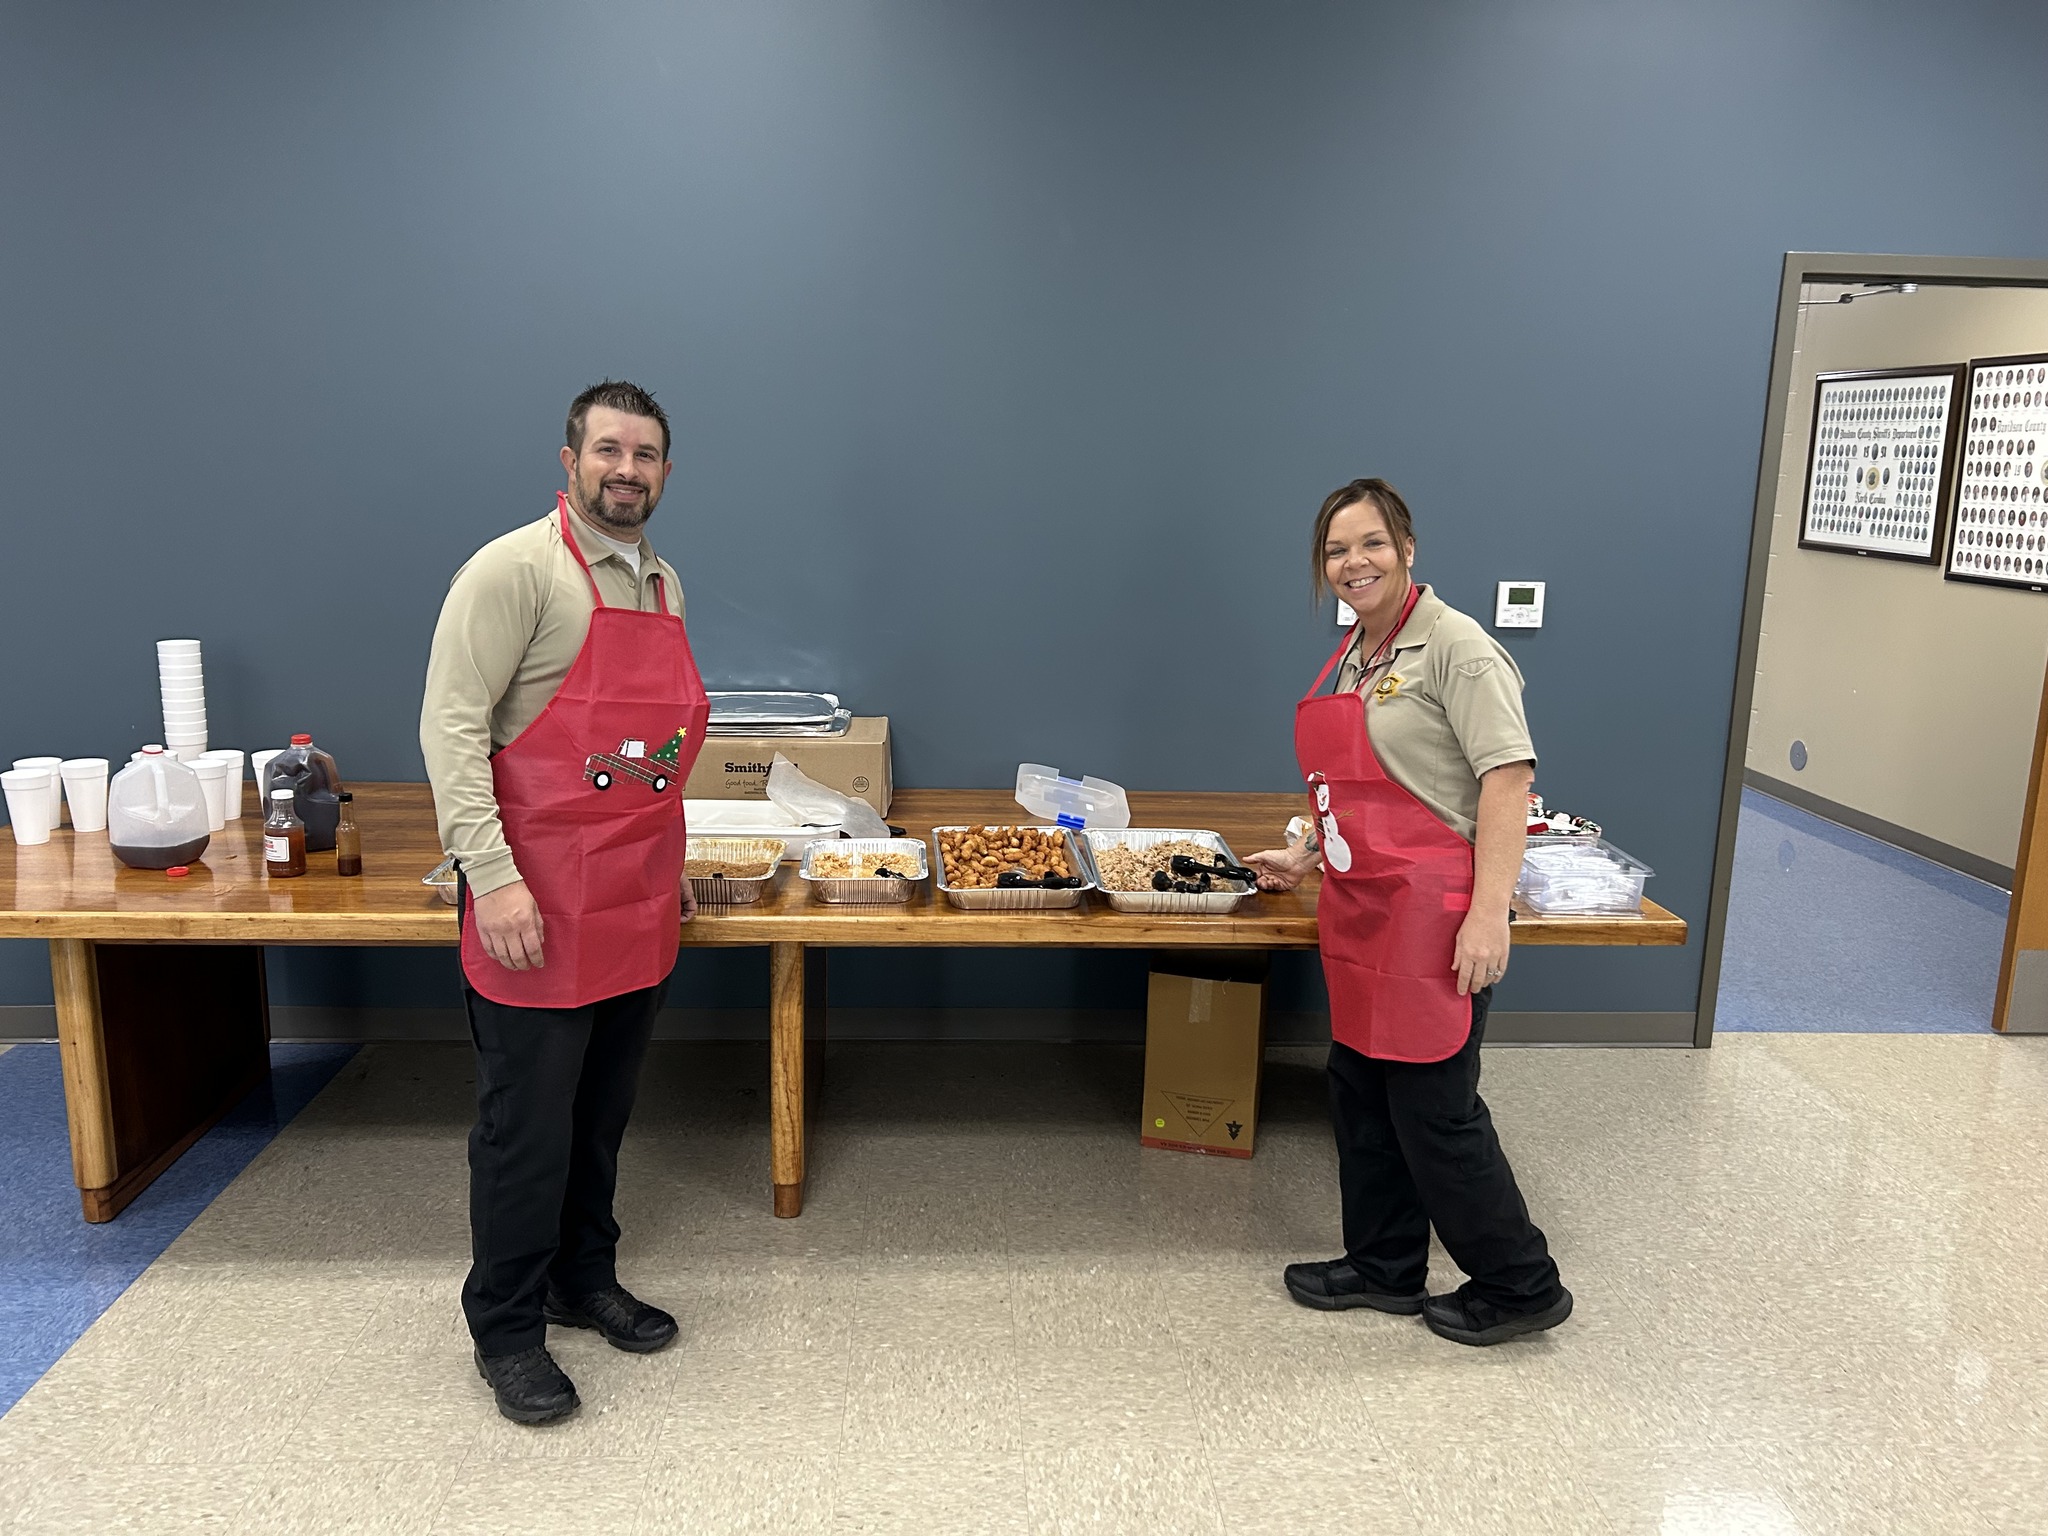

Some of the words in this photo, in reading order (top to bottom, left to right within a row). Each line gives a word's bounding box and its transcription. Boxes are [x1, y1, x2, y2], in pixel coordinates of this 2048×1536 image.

[1997, 420, 2023, 433] Davidson
[2025, 419, 2047, 435] County
[724, 761, 798, 777] Smithf
[725, 779, 742, 789] Good
